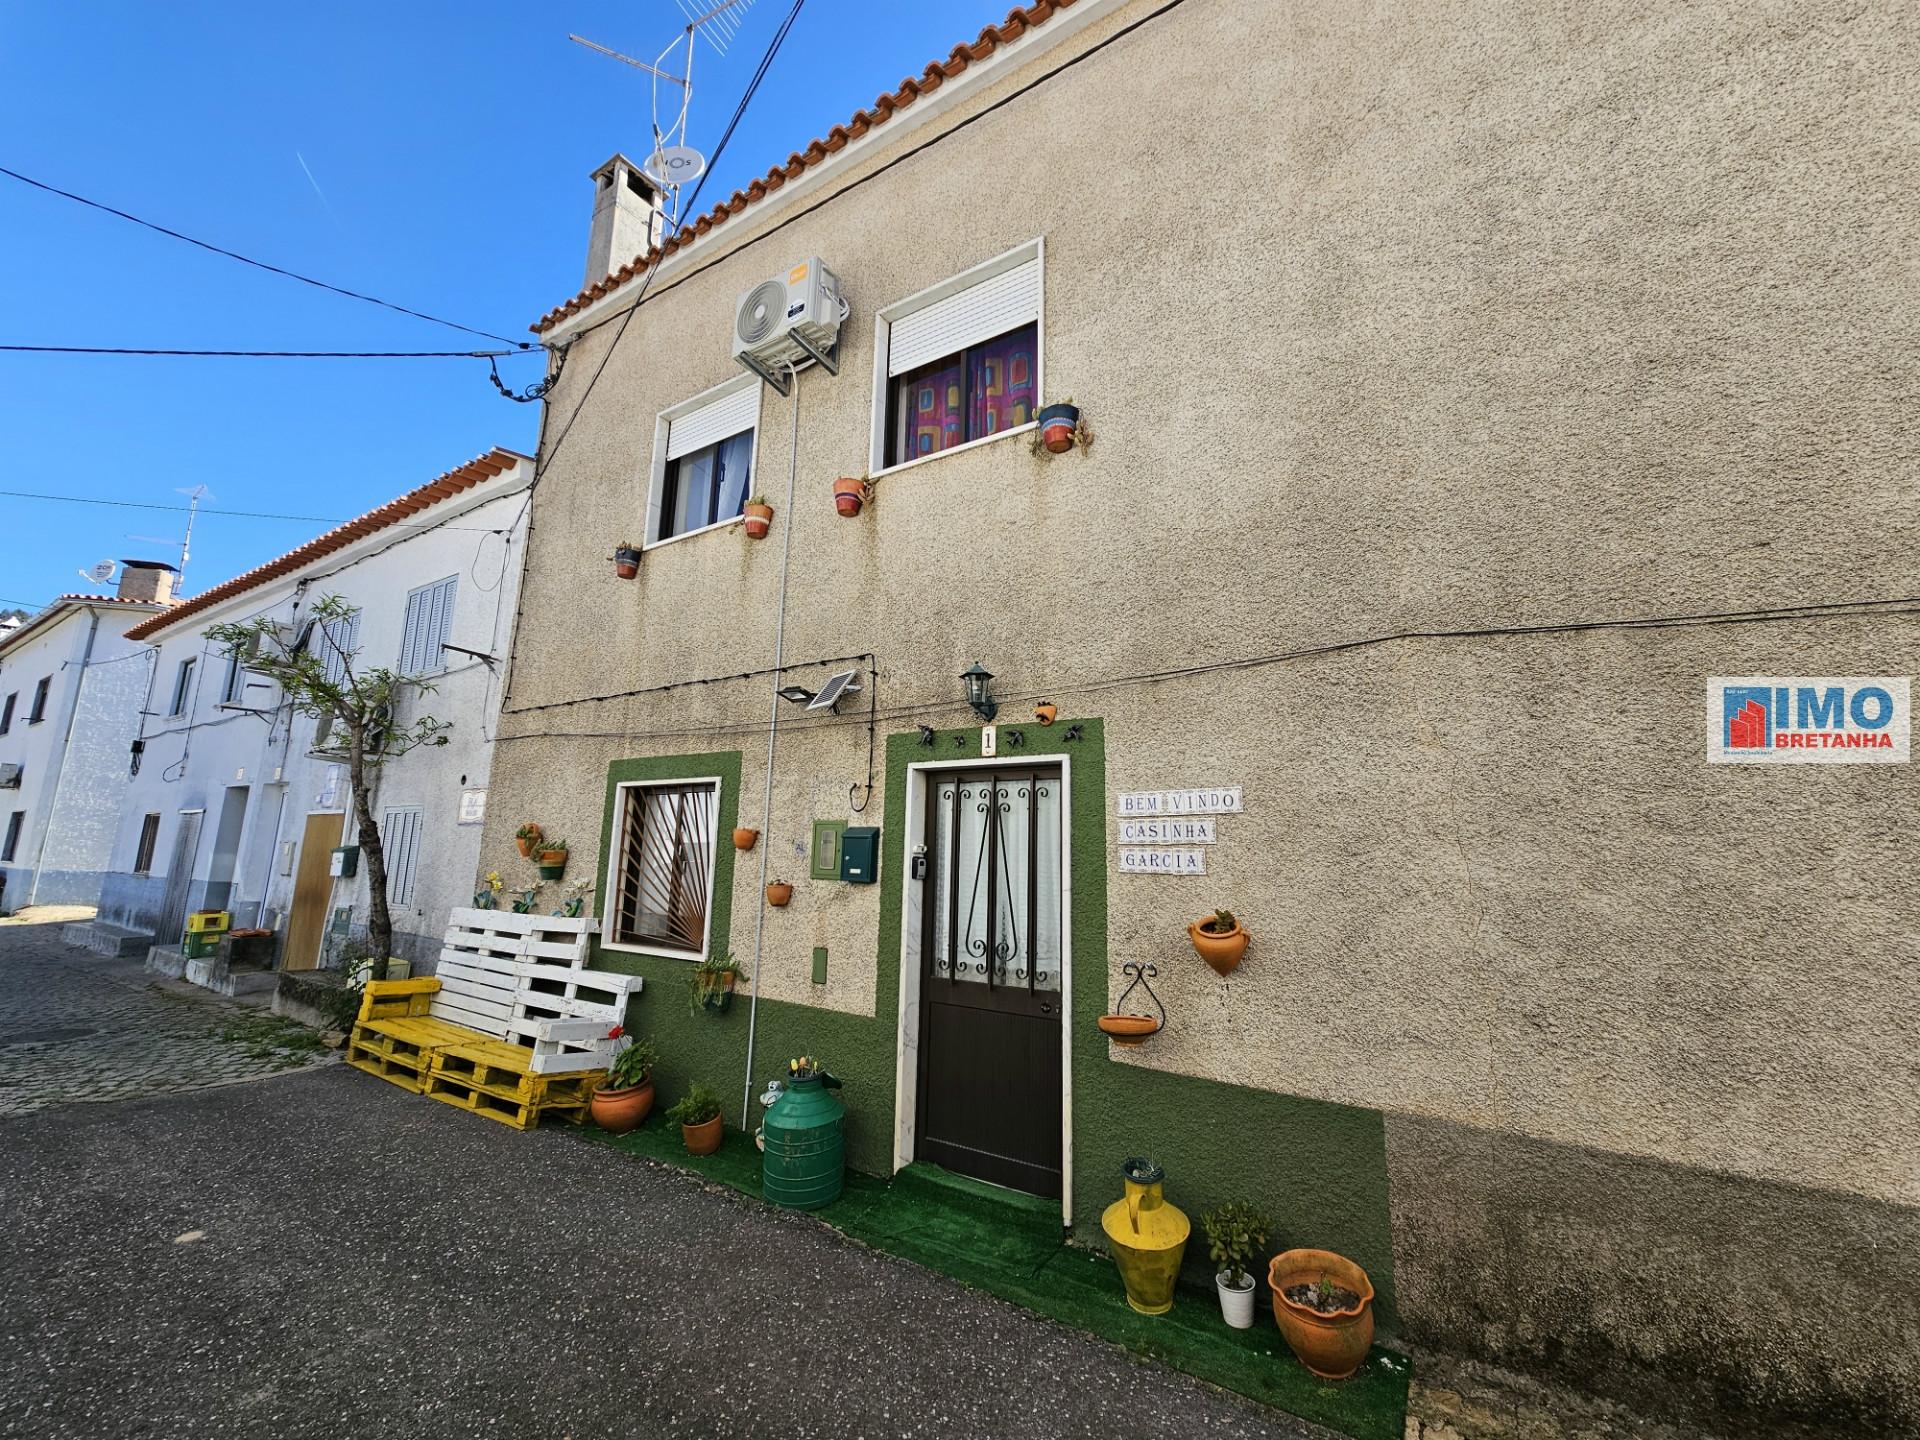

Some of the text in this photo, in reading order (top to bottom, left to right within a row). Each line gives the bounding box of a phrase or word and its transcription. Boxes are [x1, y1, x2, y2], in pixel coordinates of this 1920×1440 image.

[984, 732, 992, 749] 1
[1125, 794, 1235, 811] BEM VINDO
[1125, 824, 1208, 839] CASINHA
[1125, 853, 1198, 868] GARCIA
